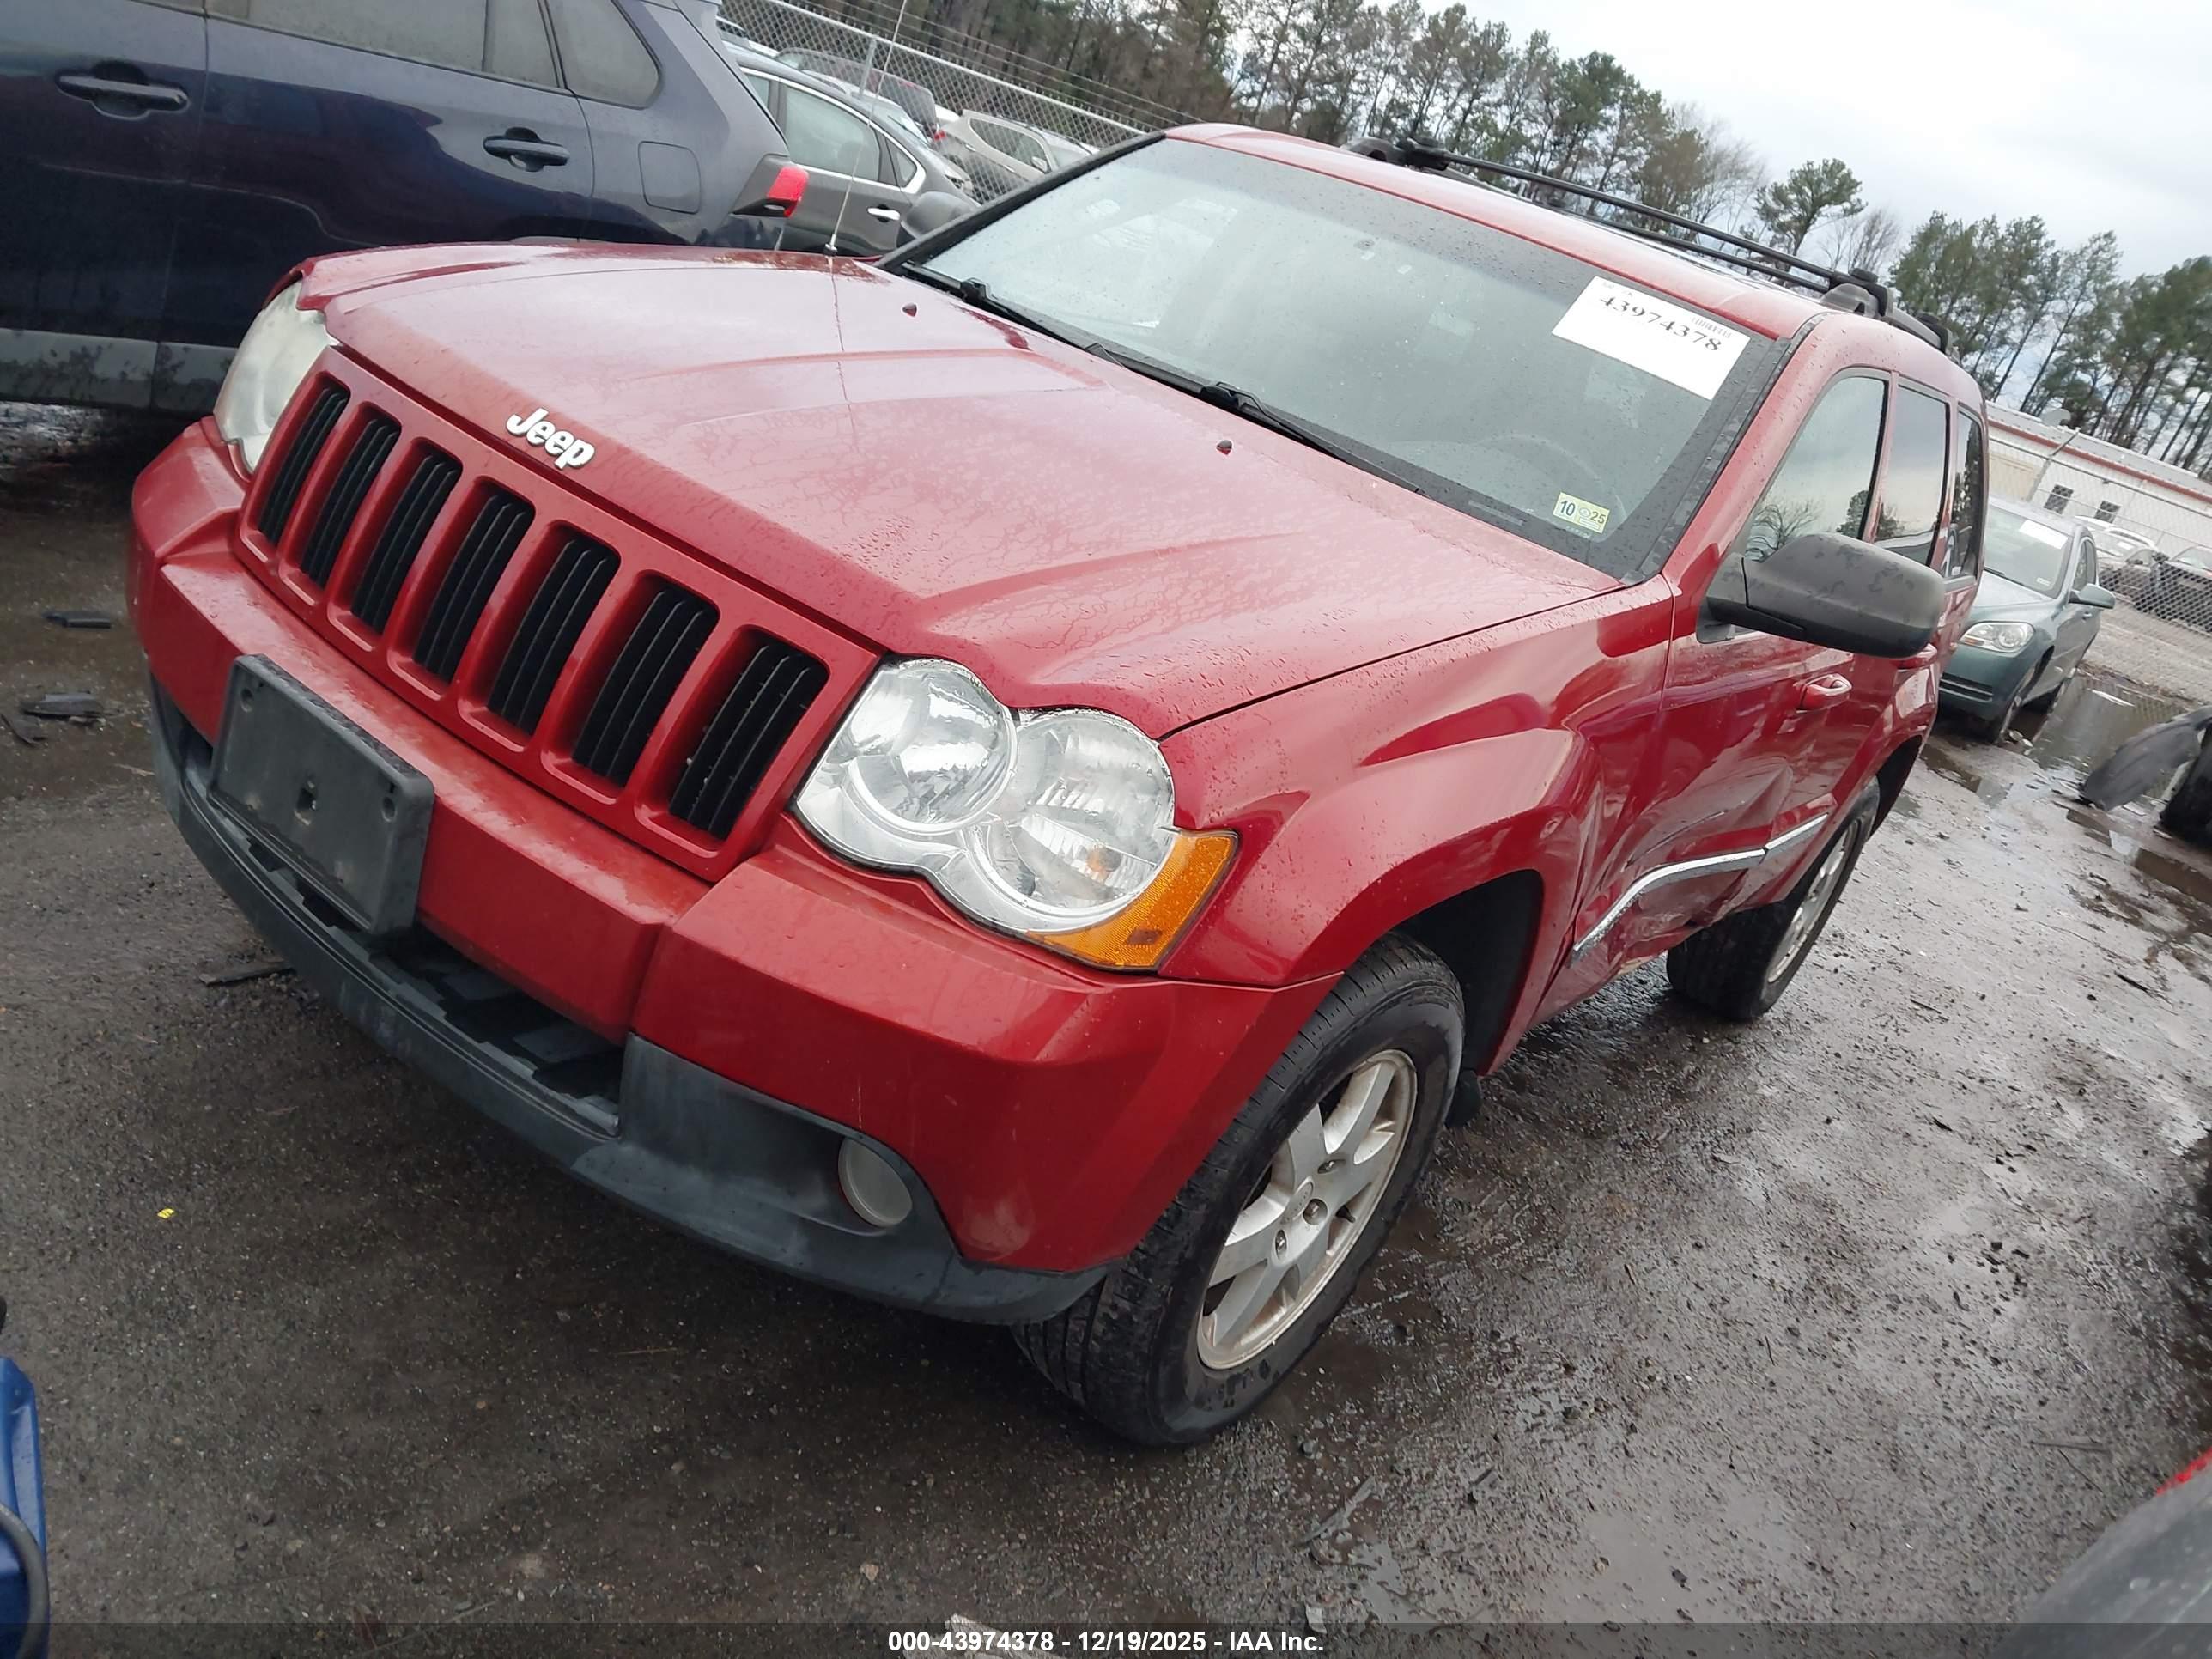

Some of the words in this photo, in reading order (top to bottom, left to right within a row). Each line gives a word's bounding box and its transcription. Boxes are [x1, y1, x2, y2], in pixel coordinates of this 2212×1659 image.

[1600, 296, 1723, 351] 43974378
[506, 407, 595, 470] Jeep
[1560, 501, 1576, 516] 10
[1590, 511, 1606, 524] 25
